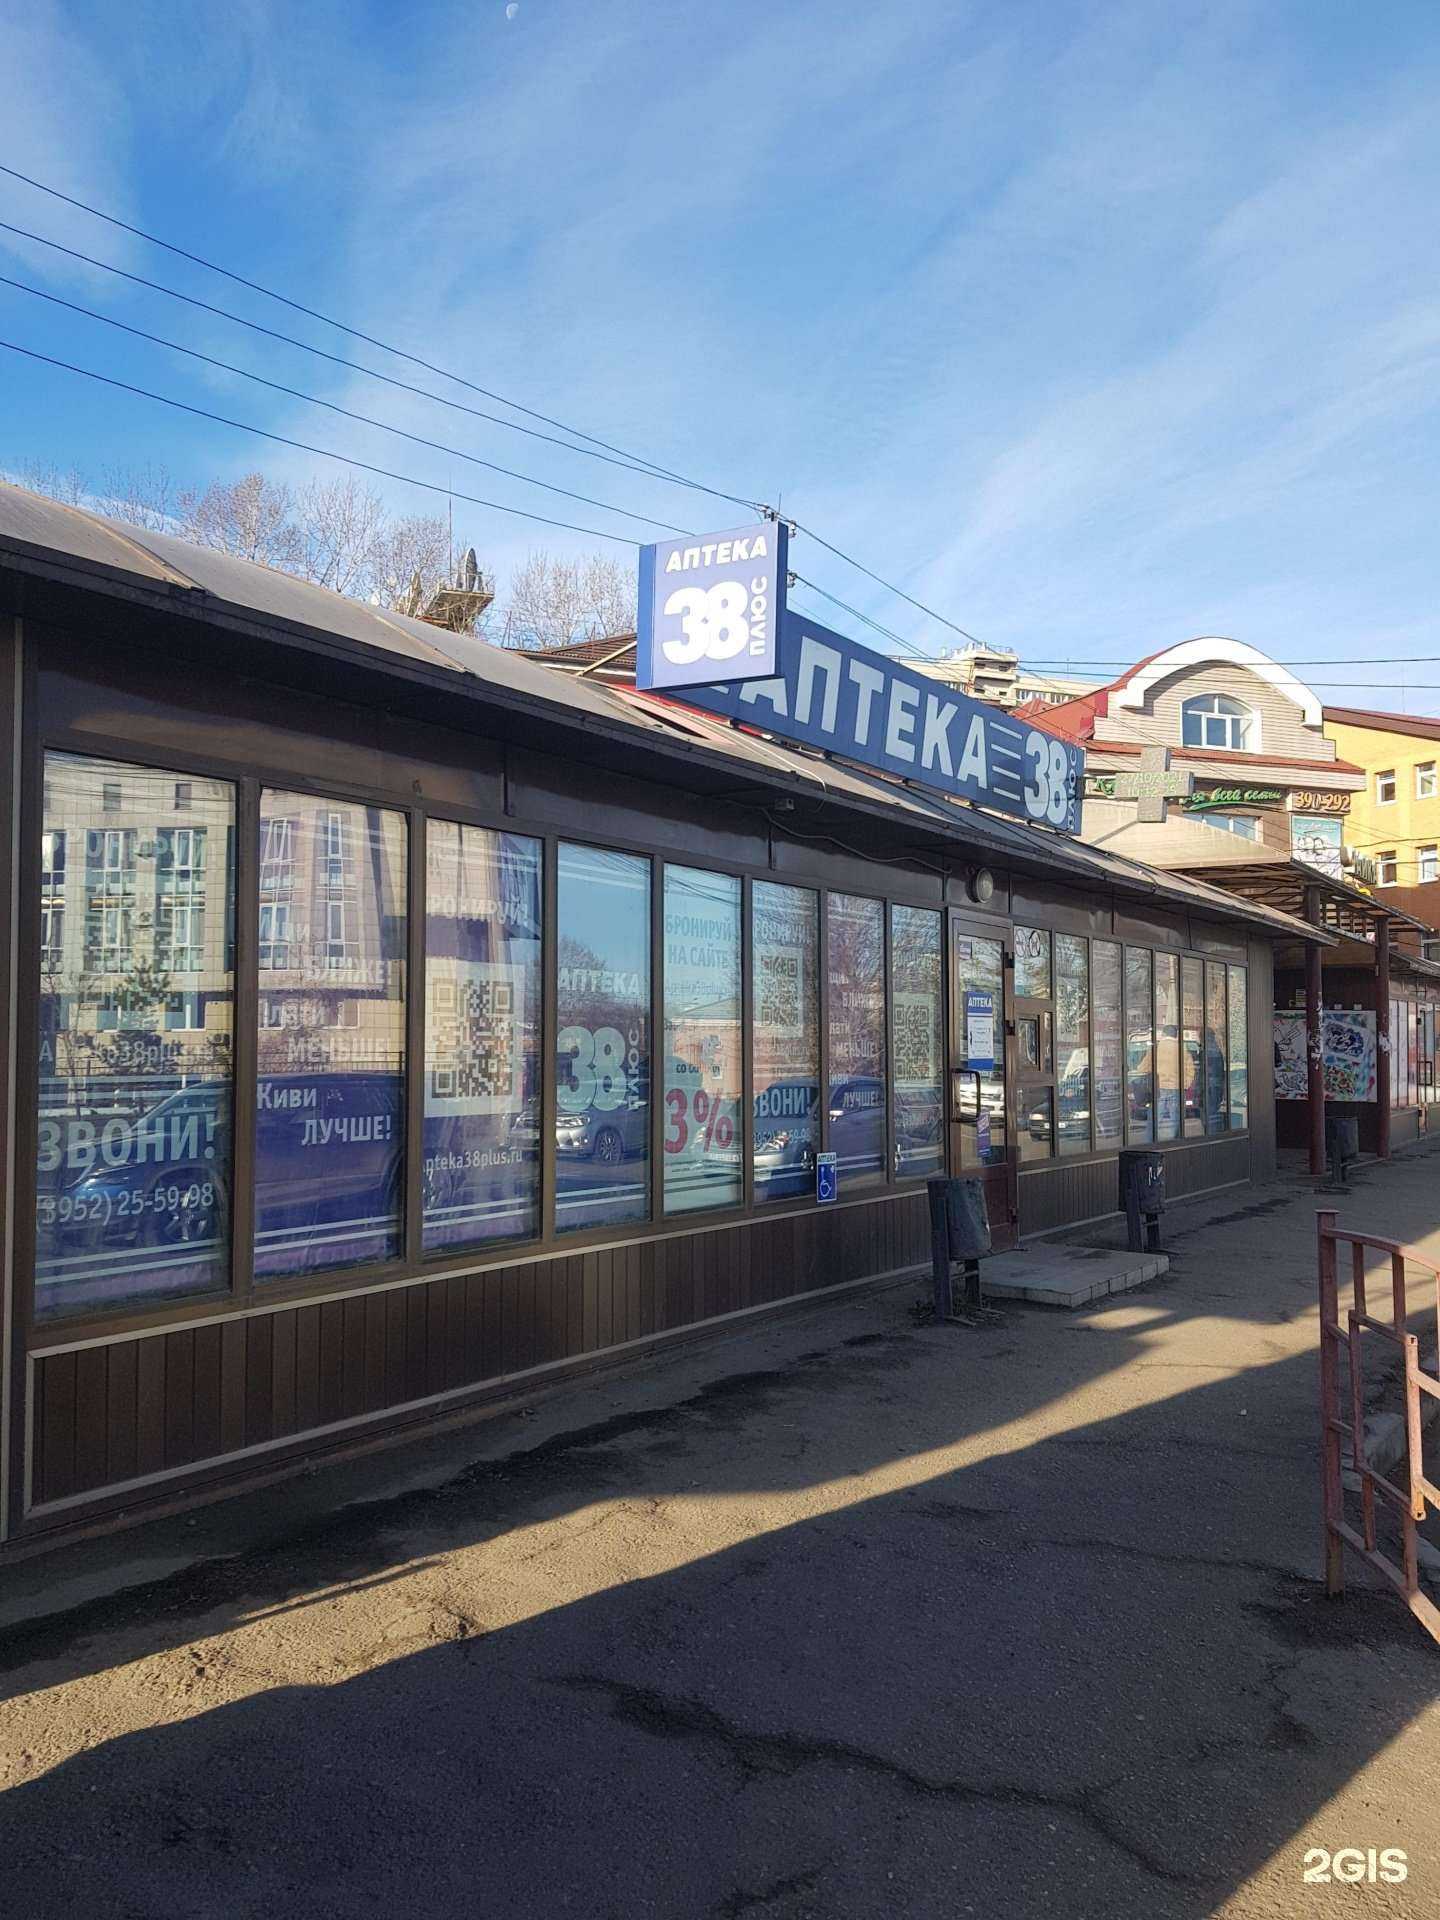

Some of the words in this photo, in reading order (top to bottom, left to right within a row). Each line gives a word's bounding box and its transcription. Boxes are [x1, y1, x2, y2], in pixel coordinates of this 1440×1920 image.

[665, 535, 768, 573] АПТЕКА
[662, 581, 750, 664] 38
[749, 576, 768, 656] ПЛЮС
[1024, 730, 1068, 824] 38
[1296, 790, 1350, 812] 390-292
[559, 967, 640, 993] АПТЕКА
[557, 1026, 627, 1111] 38
[257, 1082, 317, 1109] Киви
[37, 1114, 215, 1171] ЗВОНИ!
[301, 1115, 391, 1146] ЛУЧШЕ!
[665, 1088, 734, 1154] 3%
[424, 1148, 523, 1179] pteka38plus.ru
